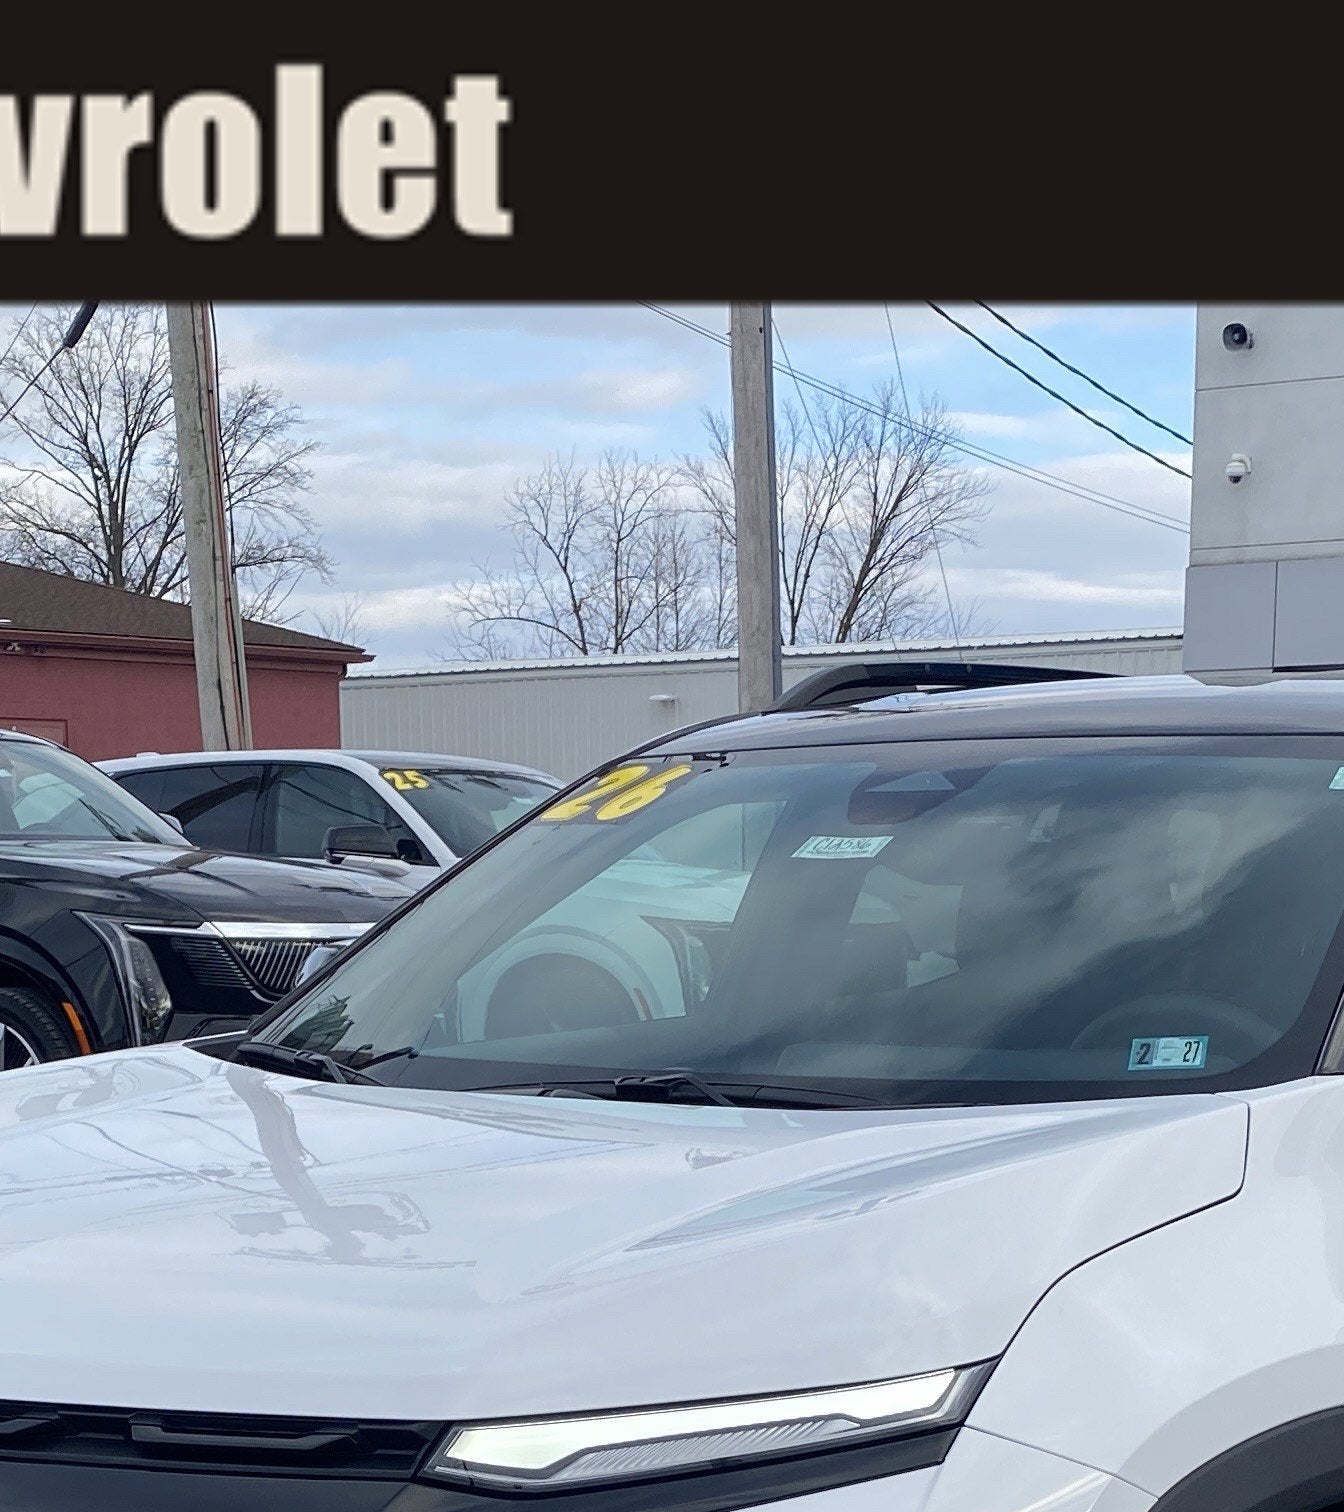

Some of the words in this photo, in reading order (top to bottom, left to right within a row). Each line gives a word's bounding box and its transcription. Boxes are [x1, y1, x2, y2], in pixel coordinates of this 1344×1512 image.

[382, 769, 430, 791] 25
[540, 763, 693, 822] 26
[1136, 1042, 1151, 1065] 2
[1182, 1040, 1201, 1063] 27
